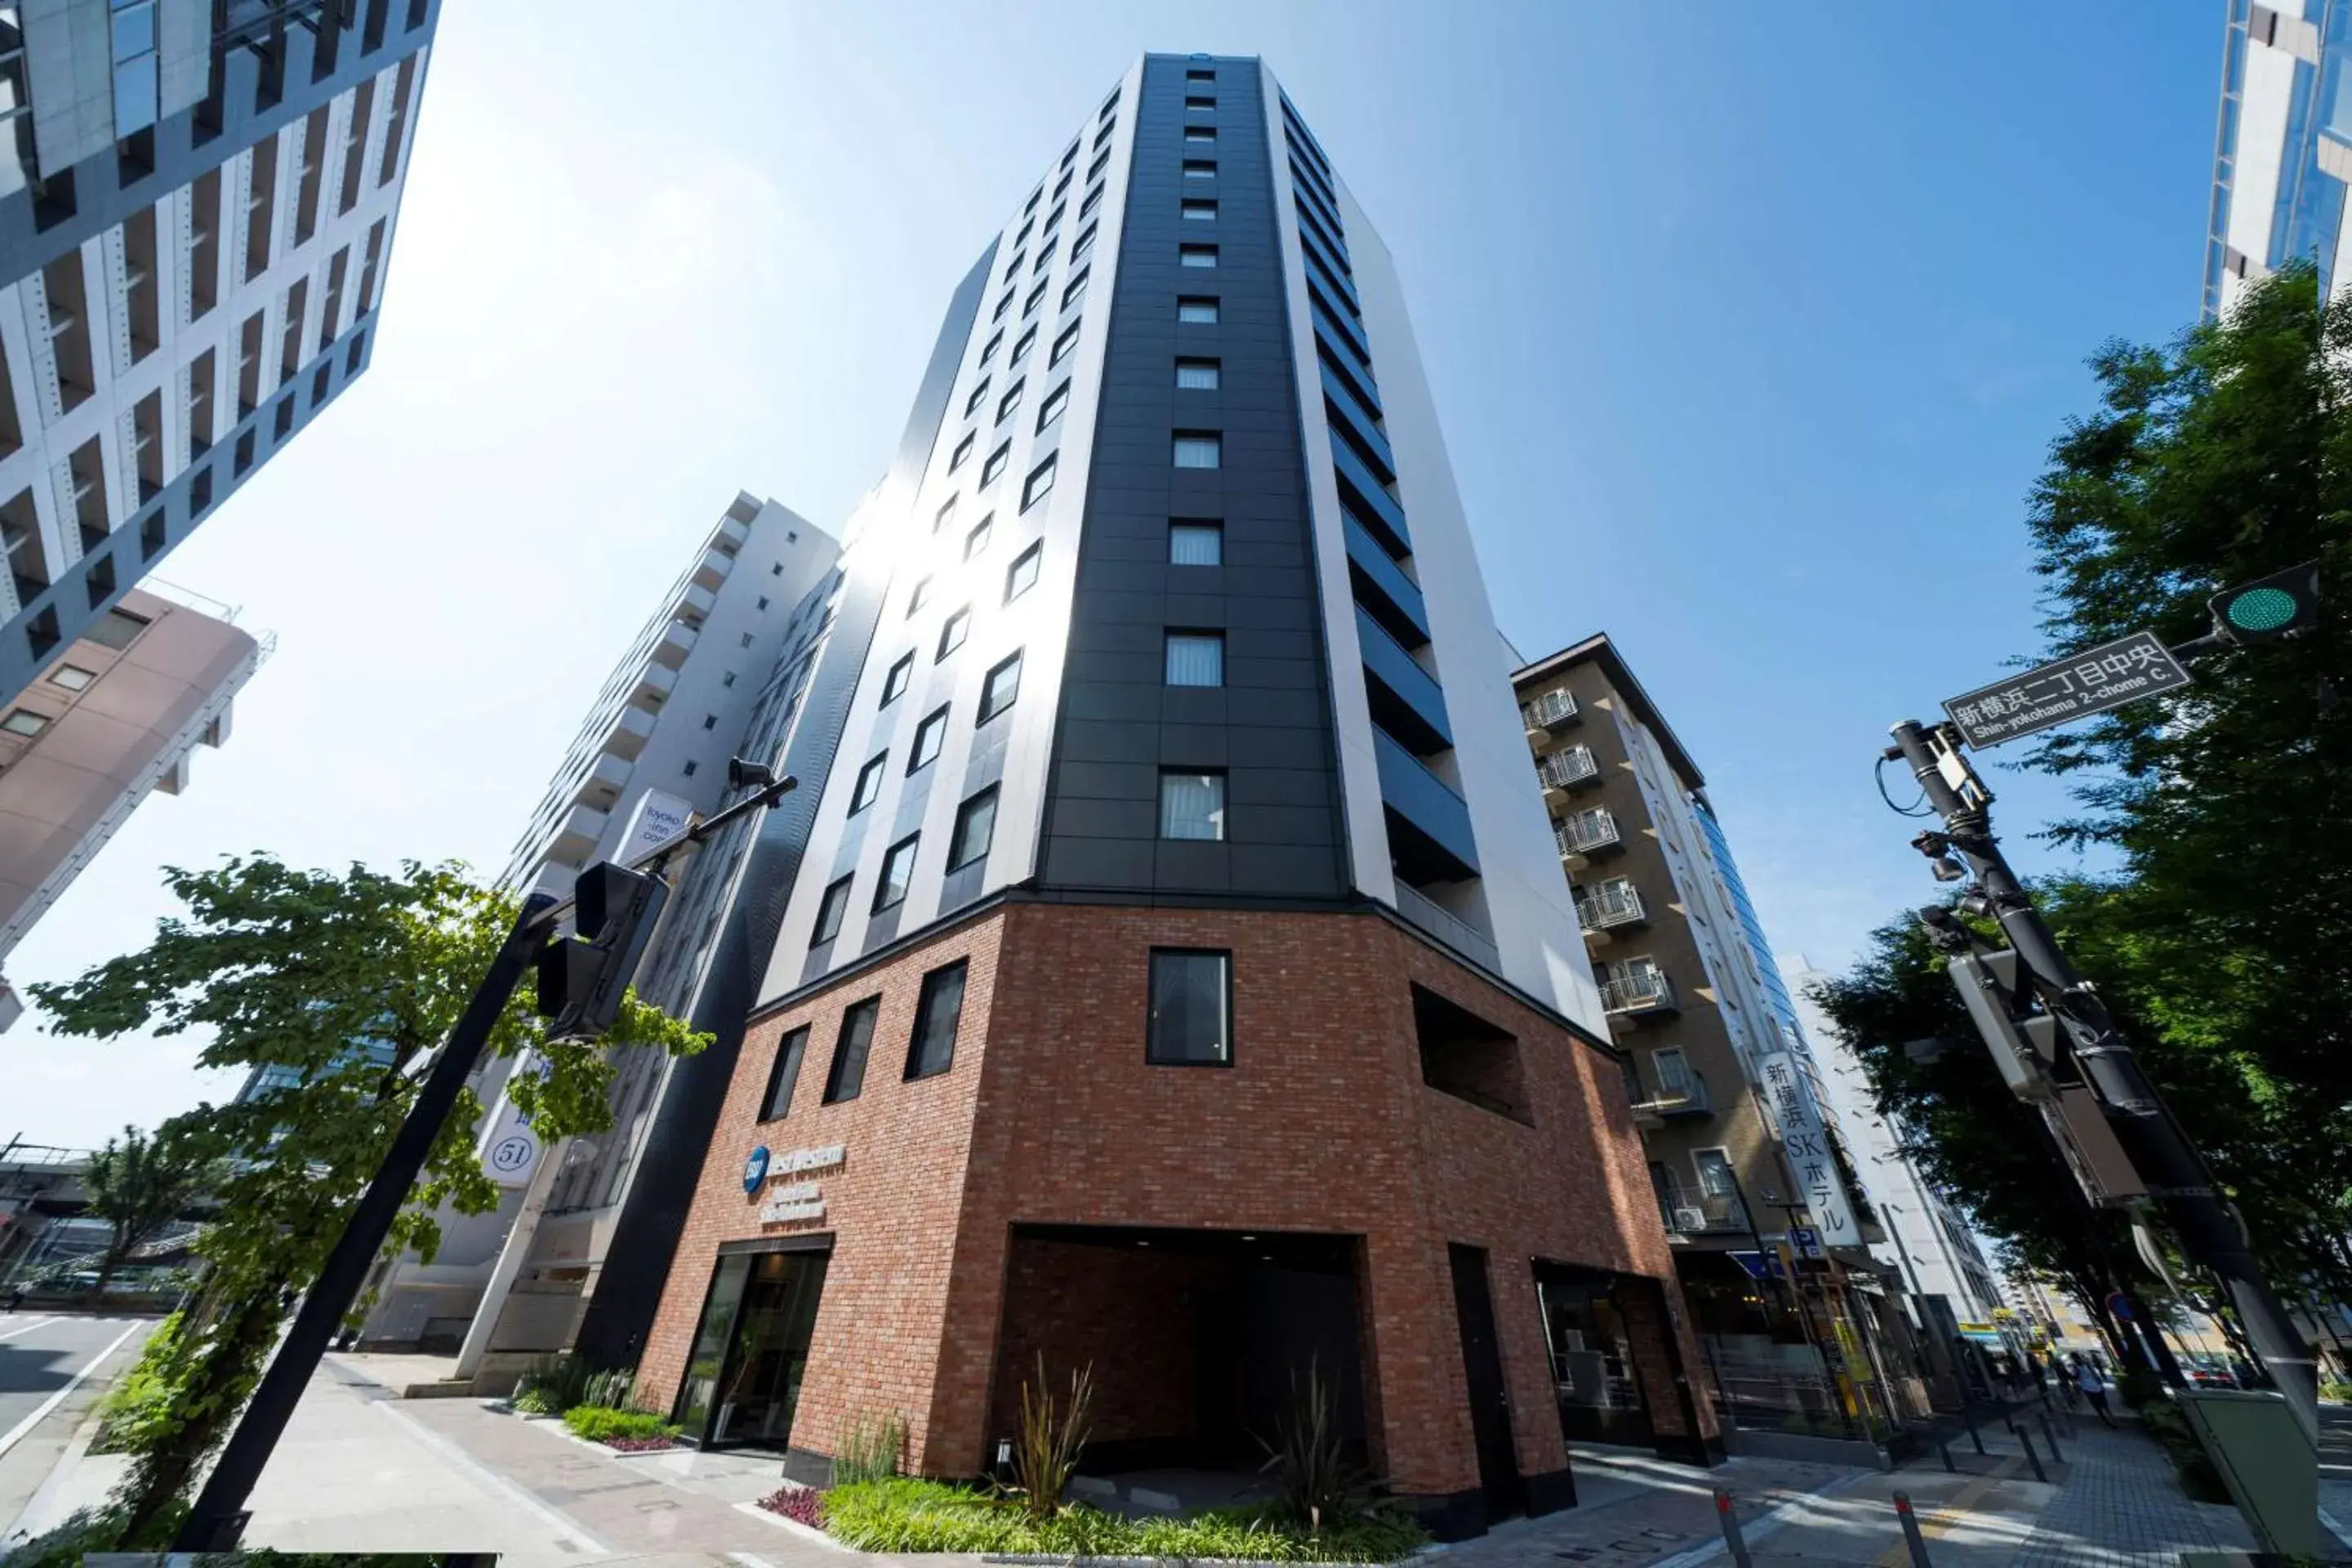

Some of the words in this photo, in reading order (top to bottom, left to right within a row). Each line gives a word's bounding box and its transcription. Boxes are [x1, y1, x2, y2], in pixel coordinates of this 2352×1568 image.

[1955, 644, 2167, 727] 新横浜二丁目中央
[1973, 698, 2078, 739] Shin-yokohama
[2079, 675, 2149, 705] 2-chome
[2150, 666, 2172, 681] C.
[499, 1144, 525, 1164] 51
